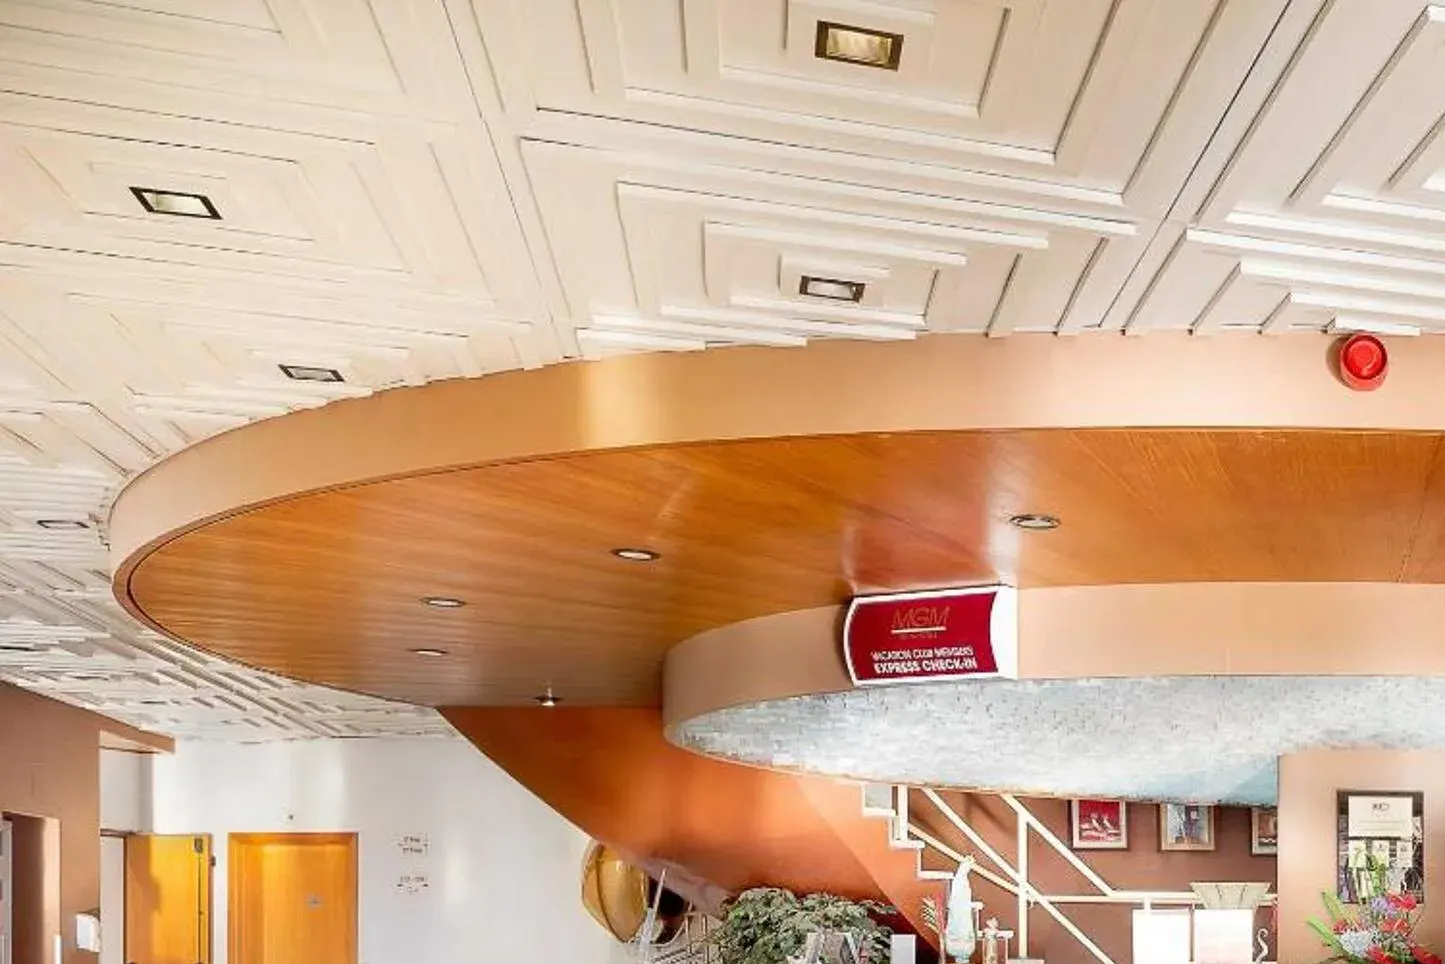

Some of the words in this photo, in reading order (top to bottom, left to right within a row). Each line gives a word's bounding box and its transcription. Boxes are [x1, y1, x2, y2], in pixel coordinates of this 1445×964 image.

[891, 606, 950, 628] MGM
[874, 661, 920, 674] EXPRESS
[922, 657, 977, 671] CHECK-IN
